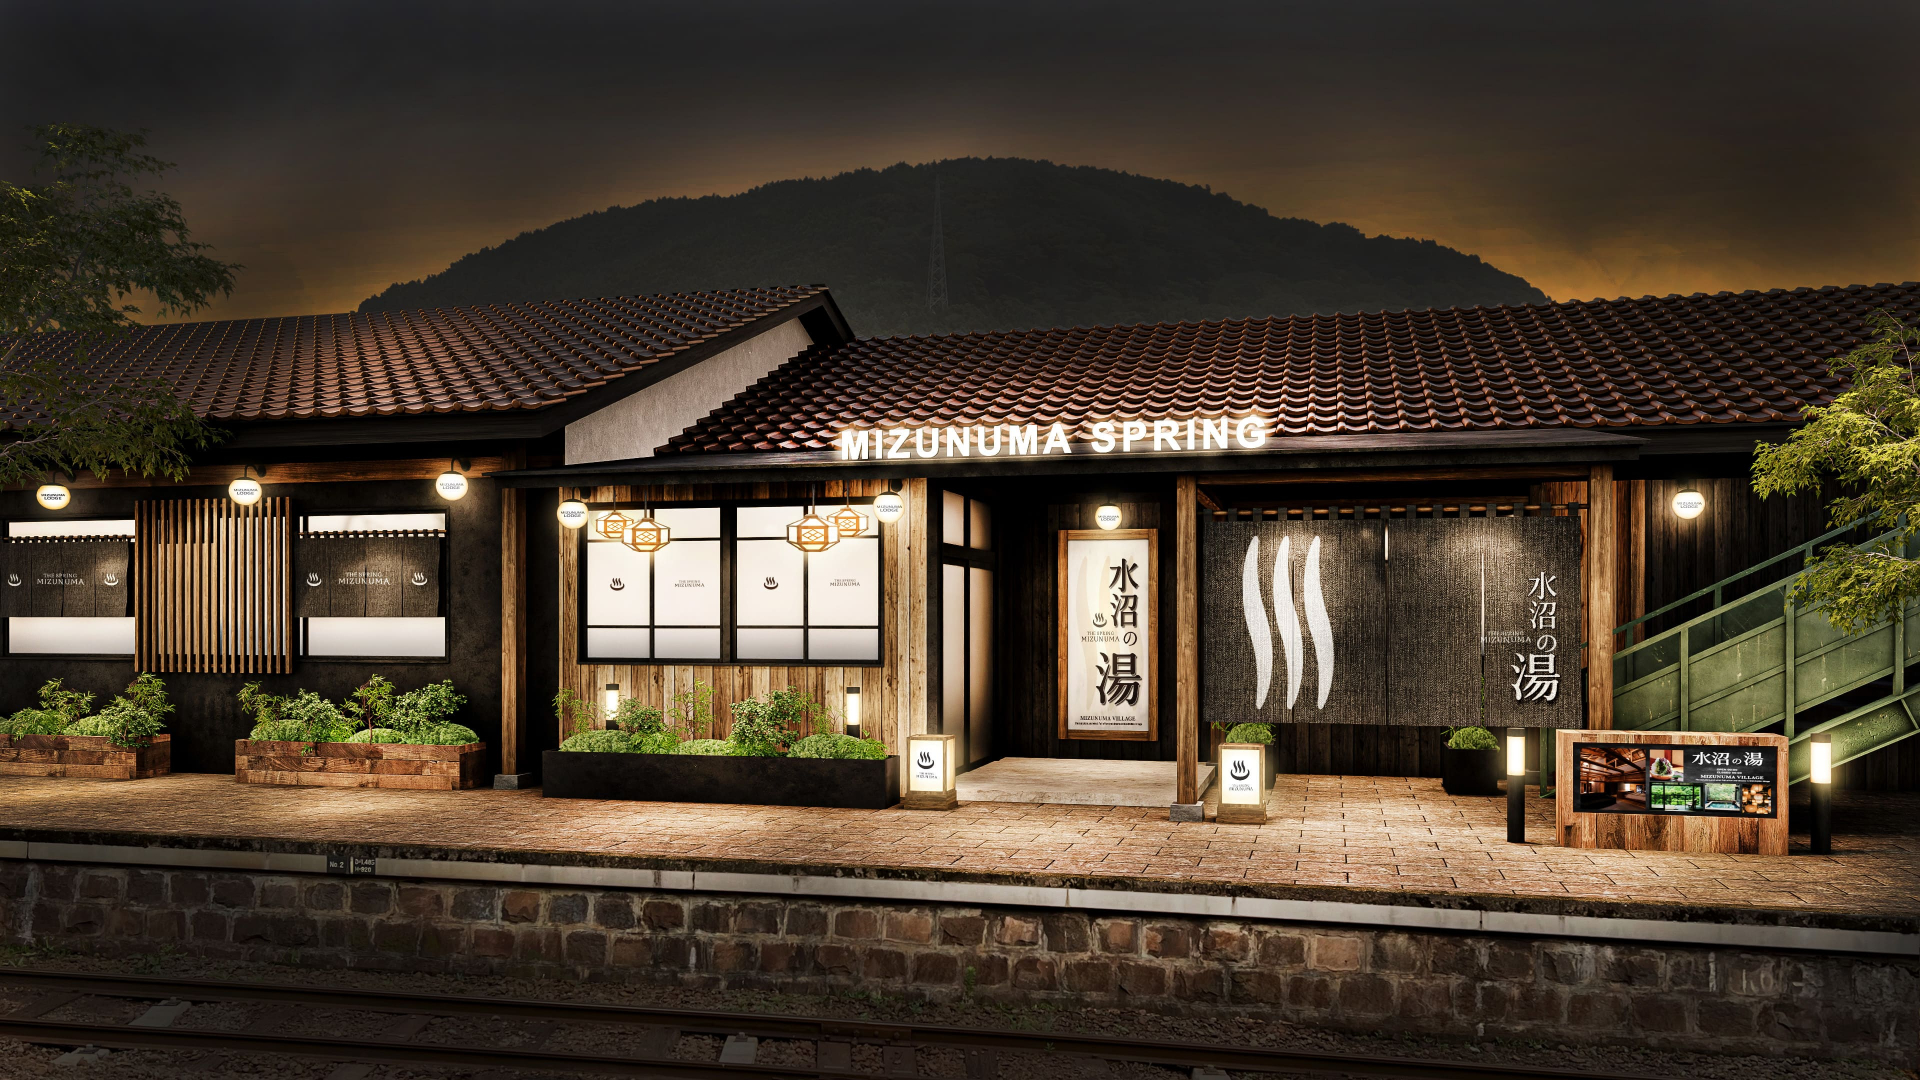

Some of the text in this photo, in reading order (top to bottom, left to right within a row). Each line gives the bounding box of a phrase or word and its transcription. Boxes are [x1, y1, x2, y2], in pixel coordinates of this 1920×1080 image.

[840, 416, 1268, 461] MIZUNUMA SPRING
[1096, 558, 1142, 706] 水沼の湯
[1511, 572, 1560, 701] 水沼の湯
[1692, 752, 1764, 766] 水沼の湯
